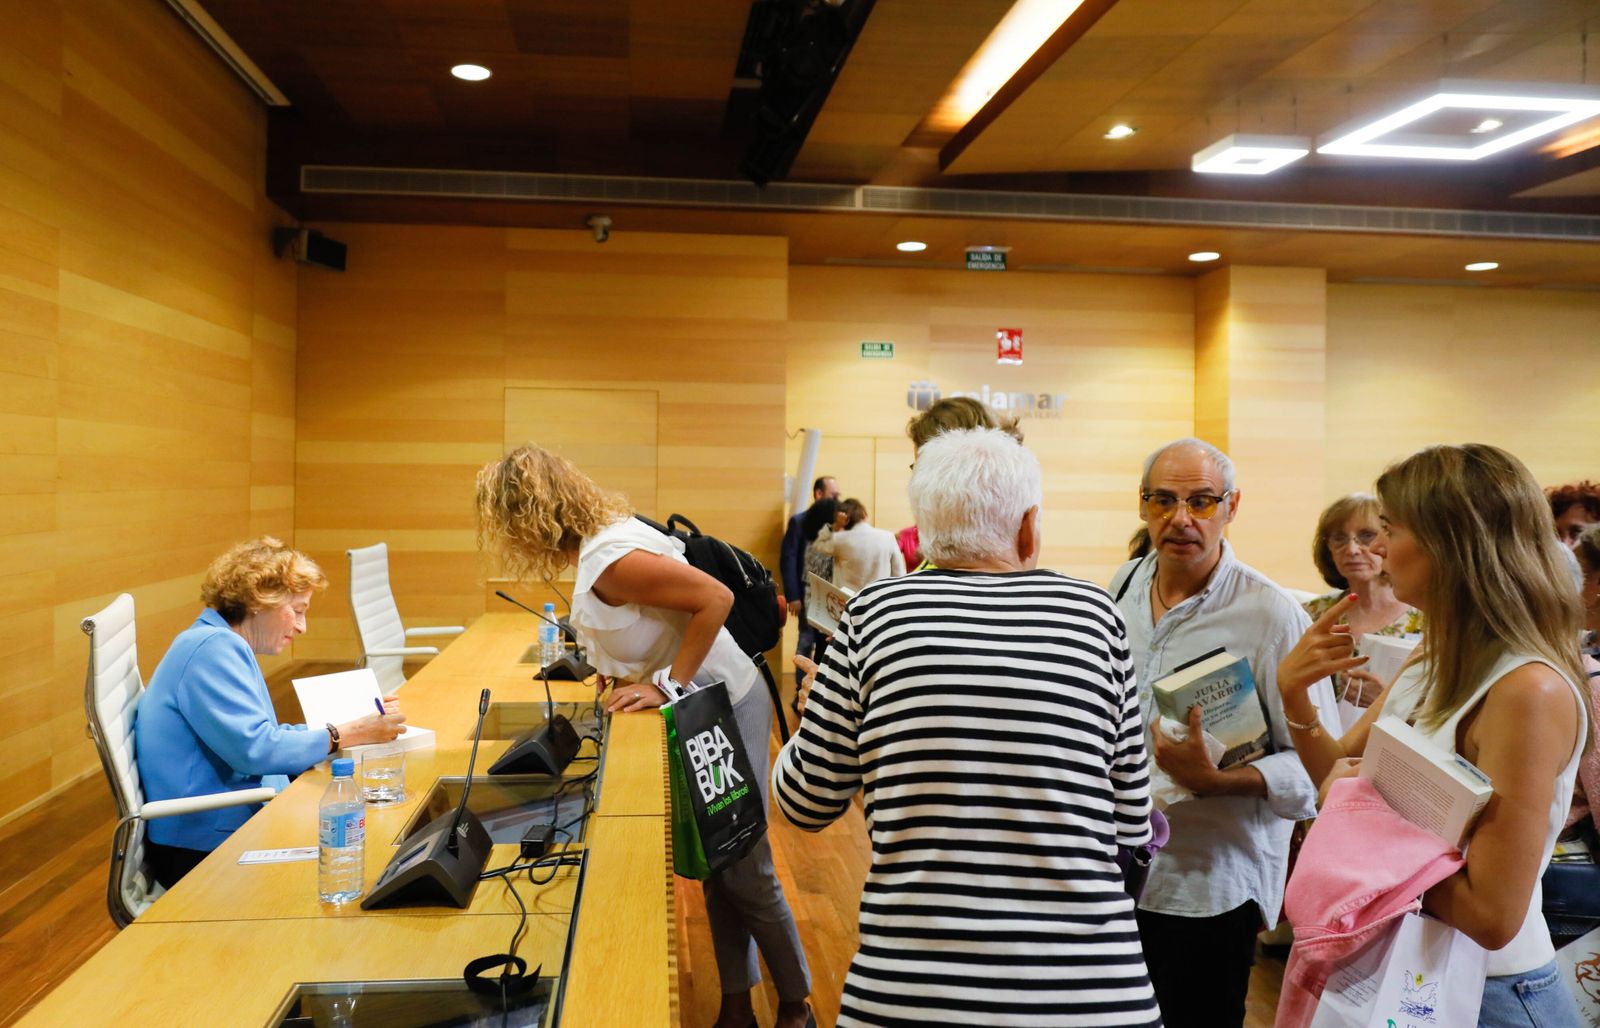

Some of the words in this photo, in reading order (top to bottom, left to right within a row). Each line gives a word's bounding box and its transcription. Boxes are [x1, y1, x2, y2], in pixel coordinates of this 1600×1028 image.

[967, 261, 1006, 270] EMERGENCIA
[970, 252, 992, 261] SALIDA
[994, 253, 1003, 261] DE
[1194, 679, 1229, 699] JULIA
[686, 725, 734, 772] BIBA
[695, 752, 745, 804] BUK
